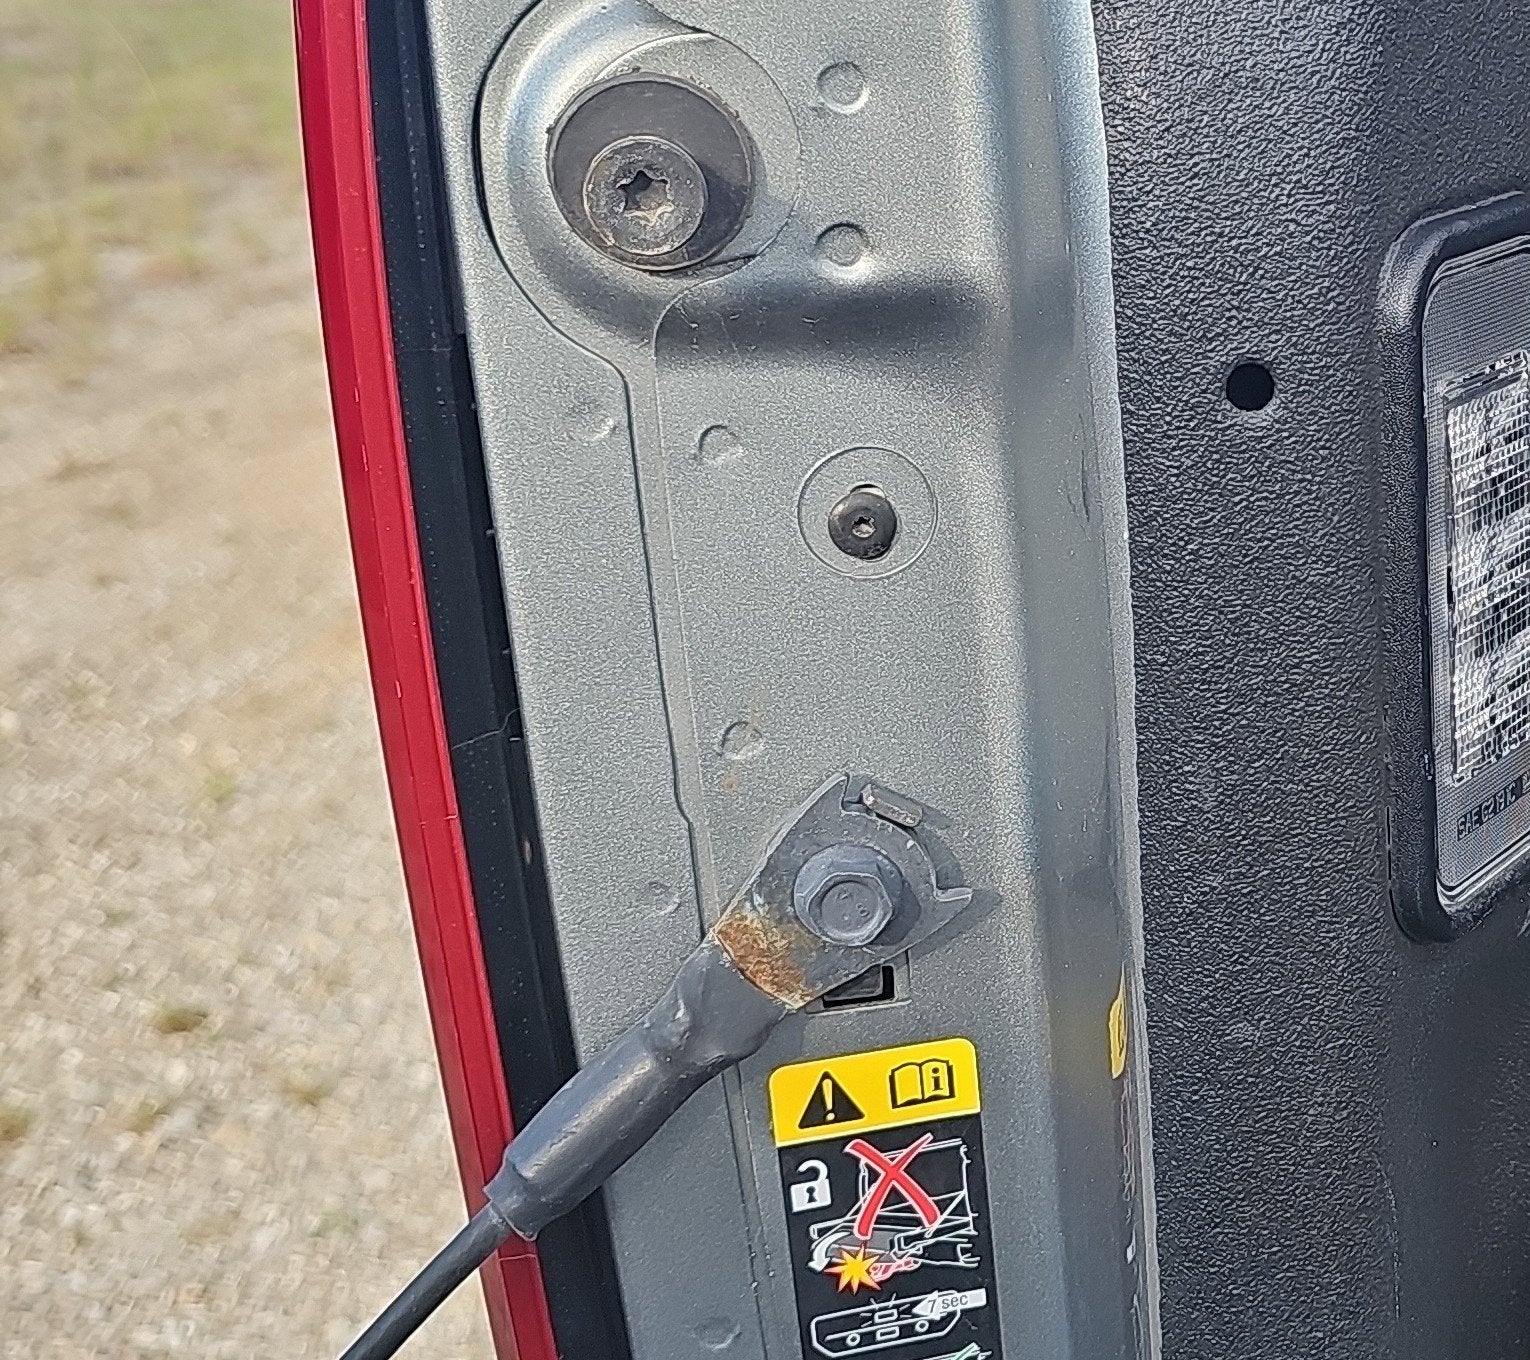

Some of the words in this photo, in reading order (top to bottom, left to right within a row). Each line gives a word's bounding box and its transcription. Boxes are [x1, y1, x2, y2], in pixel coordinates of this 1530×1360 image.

[1458, 806, 1480, 839] SAE
[927, 1299, 936, 1314] 7
[941, 1294, 969, 1310] sec
